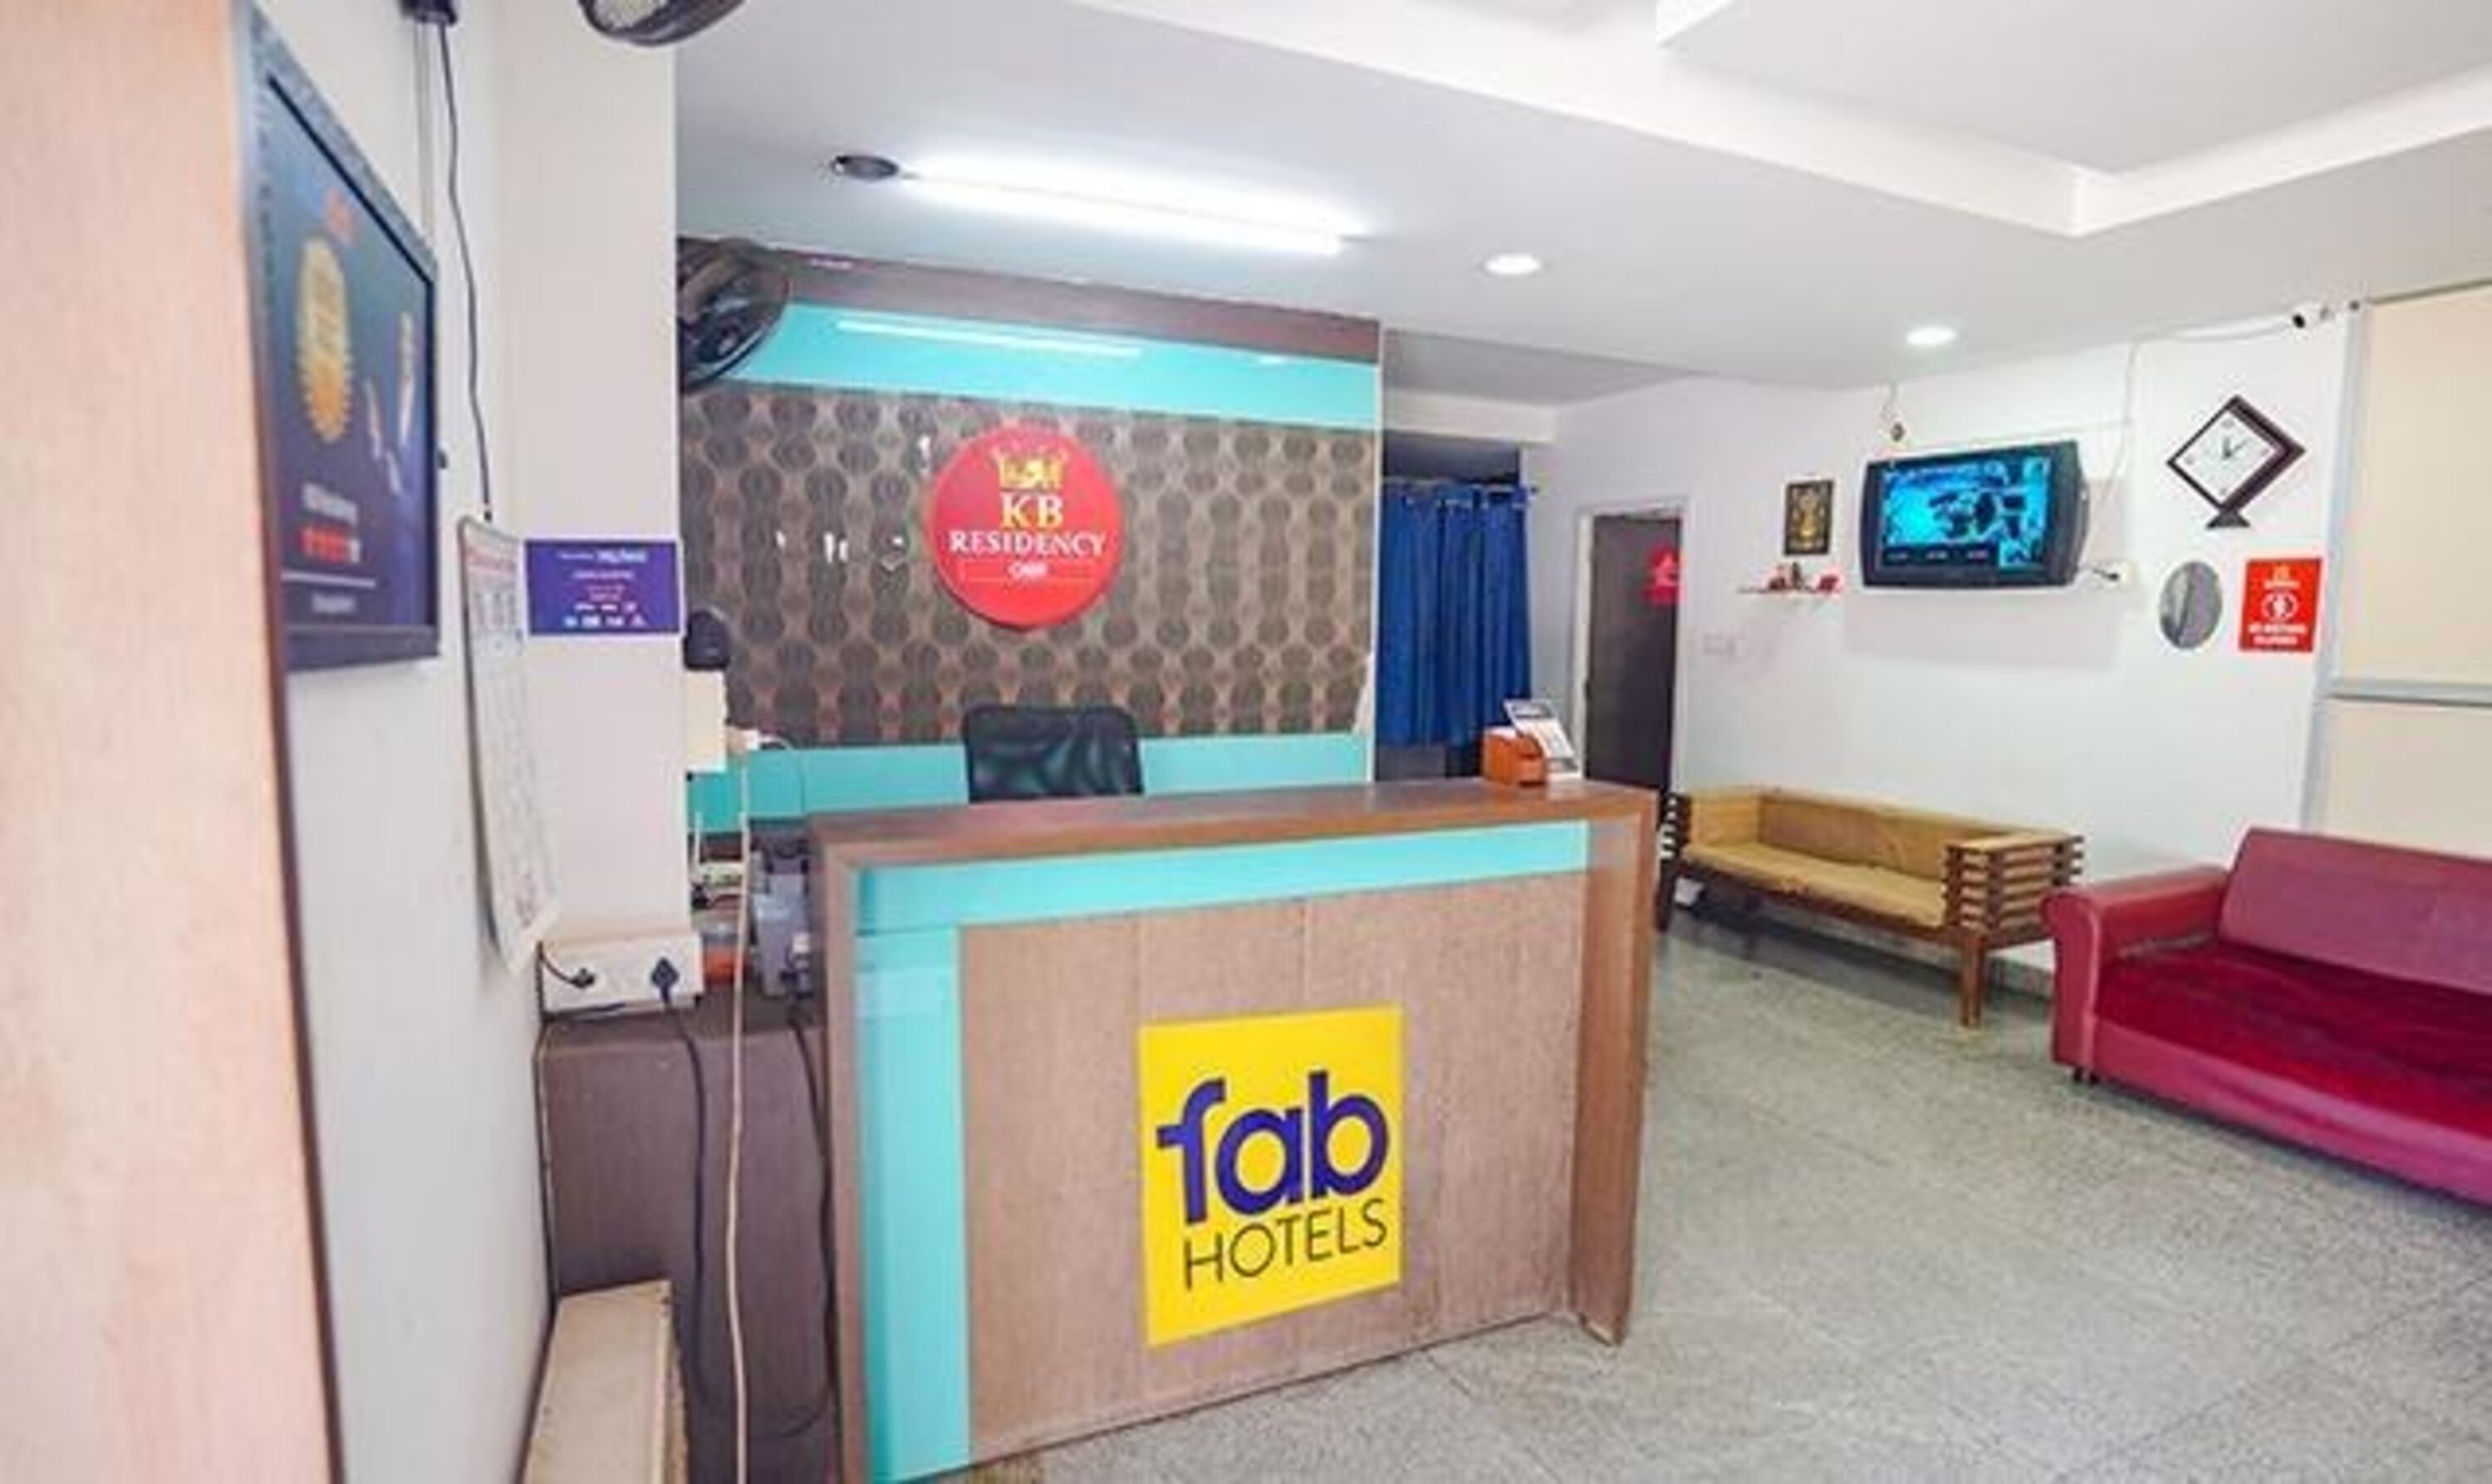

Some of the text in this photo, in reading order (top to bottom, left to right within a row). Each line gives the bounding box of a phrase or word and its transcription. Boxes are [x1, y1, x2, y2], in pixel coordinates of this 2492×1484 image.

[1001, 492, 1063, 529] KB
[949, 530, 1107, 557] RESIDENCY
[1155, 1070, 1390, 1226] fab
[1183, 1197, 1388, 1291] HOTELS
